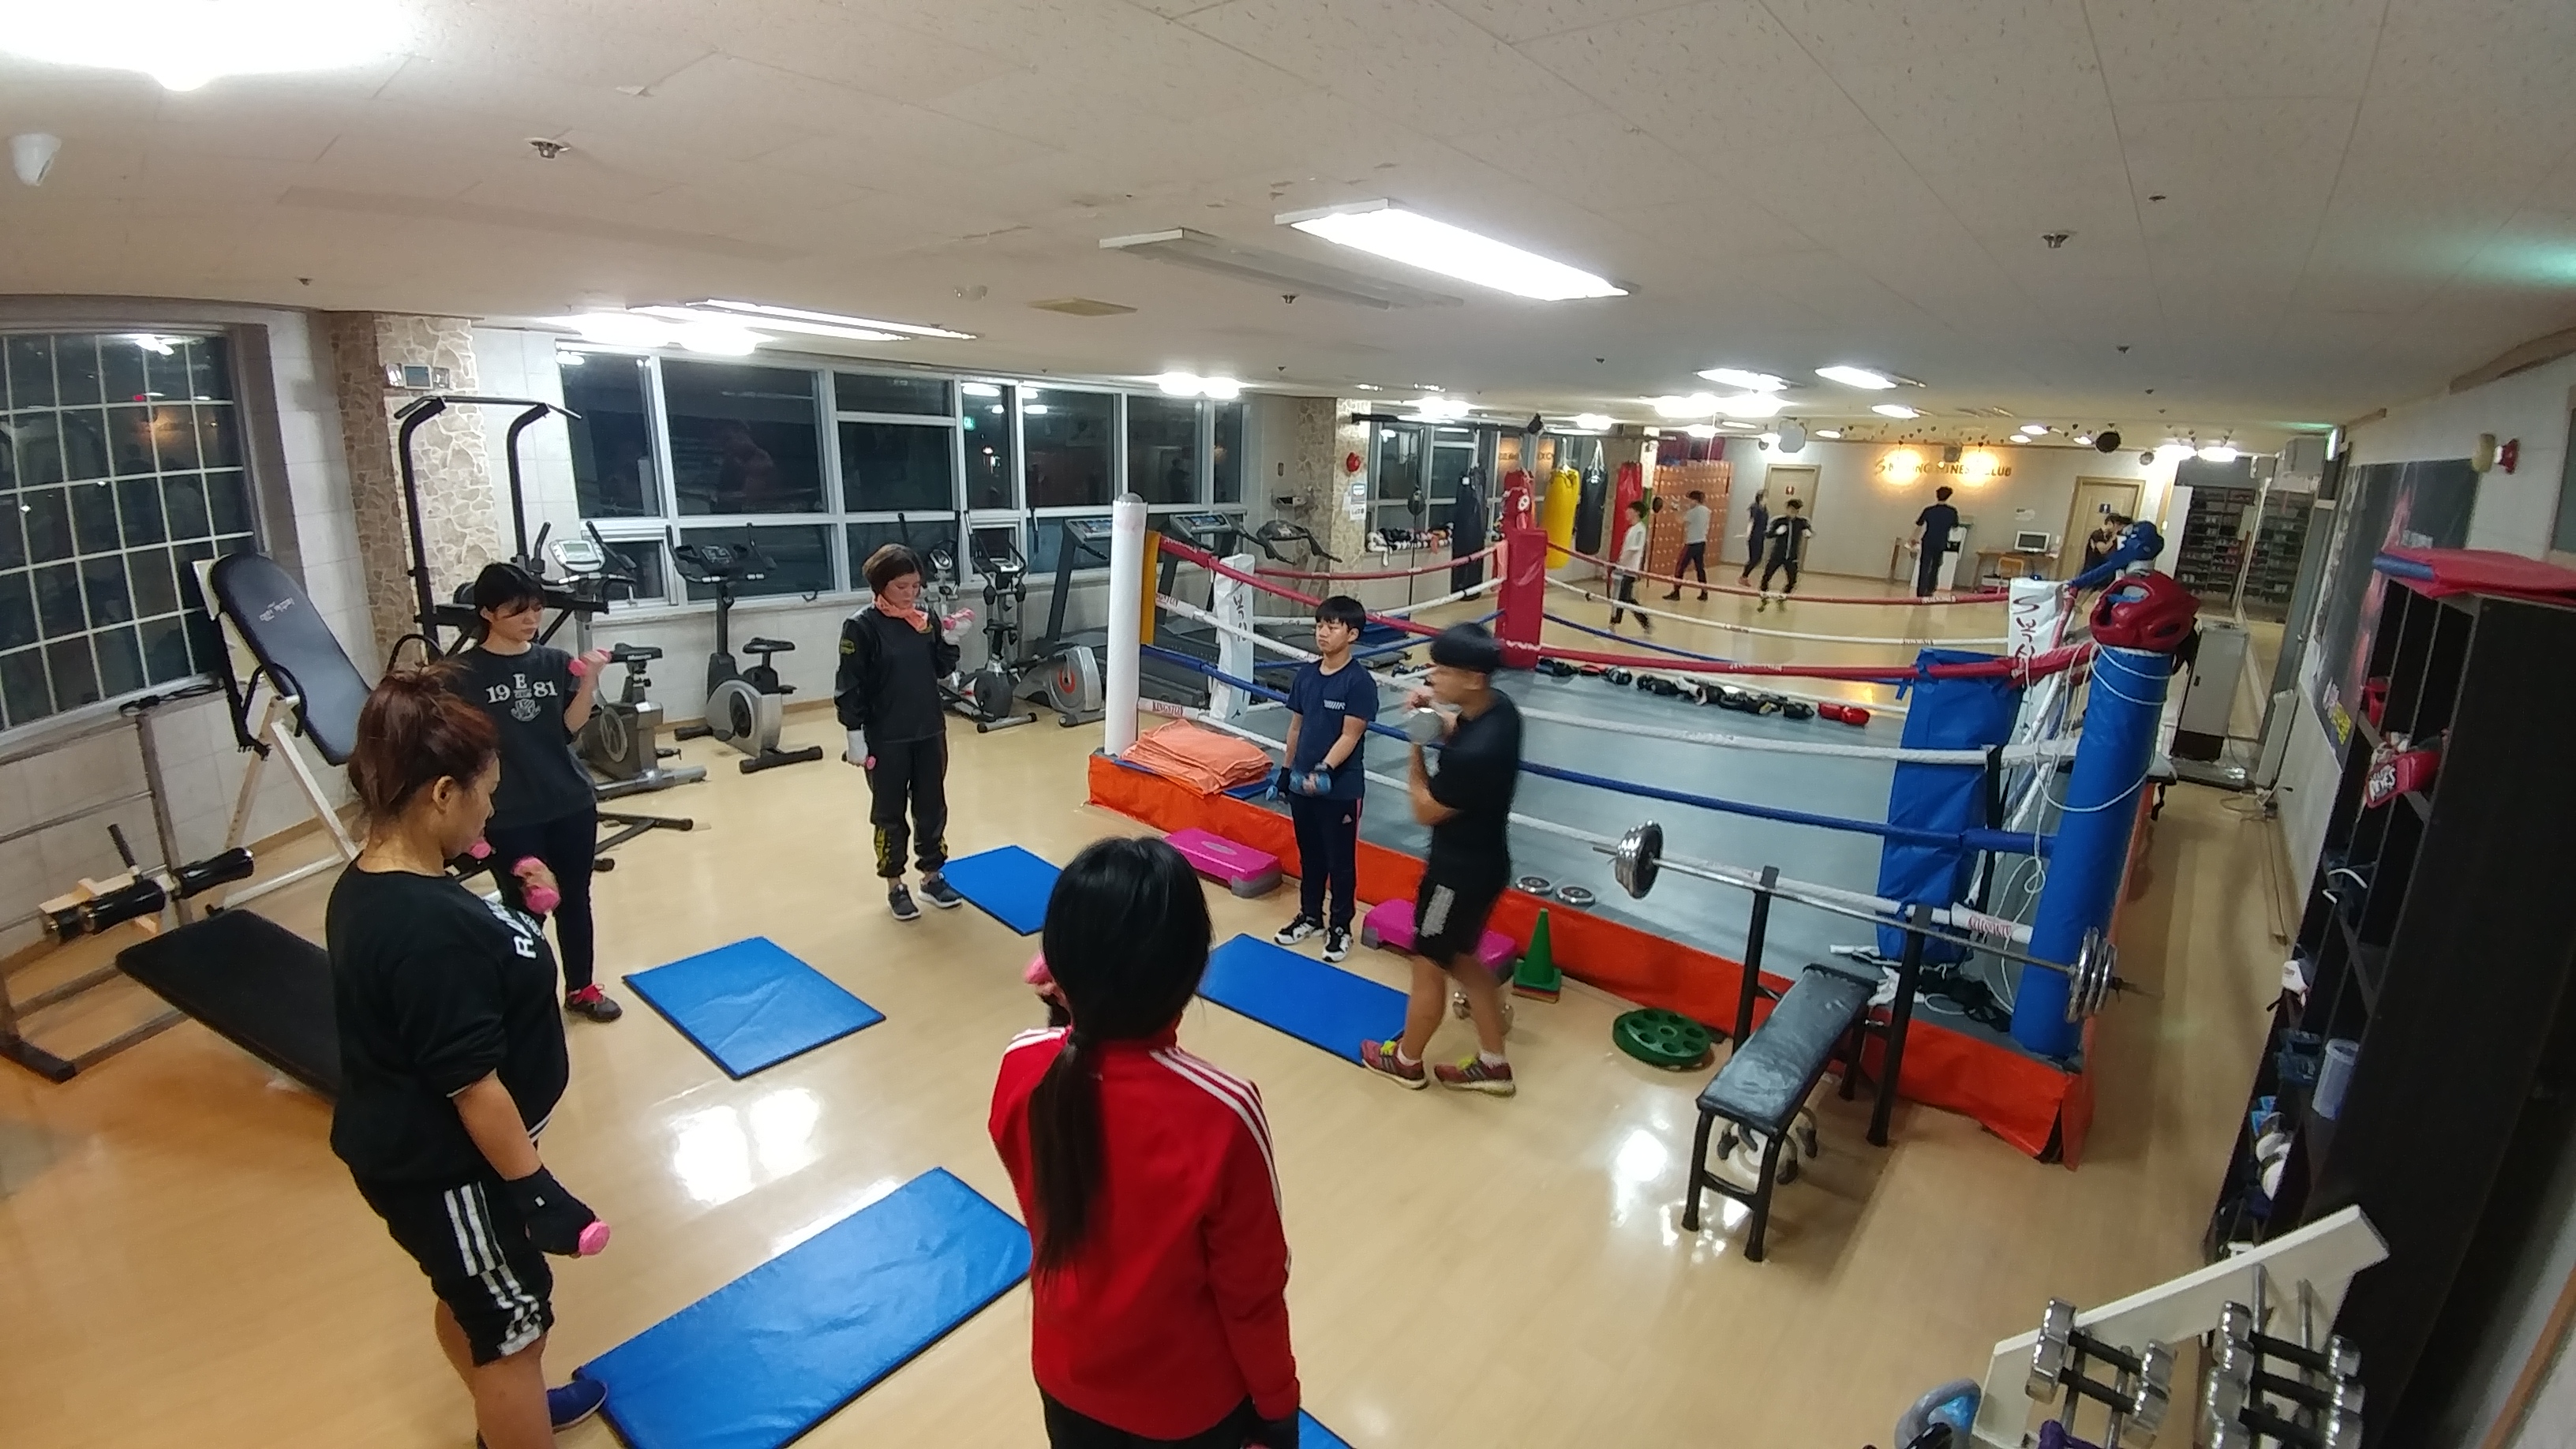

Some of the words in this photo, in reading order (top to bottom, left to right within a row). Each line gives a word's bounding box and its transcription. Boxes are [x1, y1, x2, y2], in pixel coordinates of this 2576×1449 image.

[1983, 465, 2012, 477] LUB
[512, 673, 528, 689] E
[485, 683, 511, 704] 19
[533, 680, 559, 698] 81
